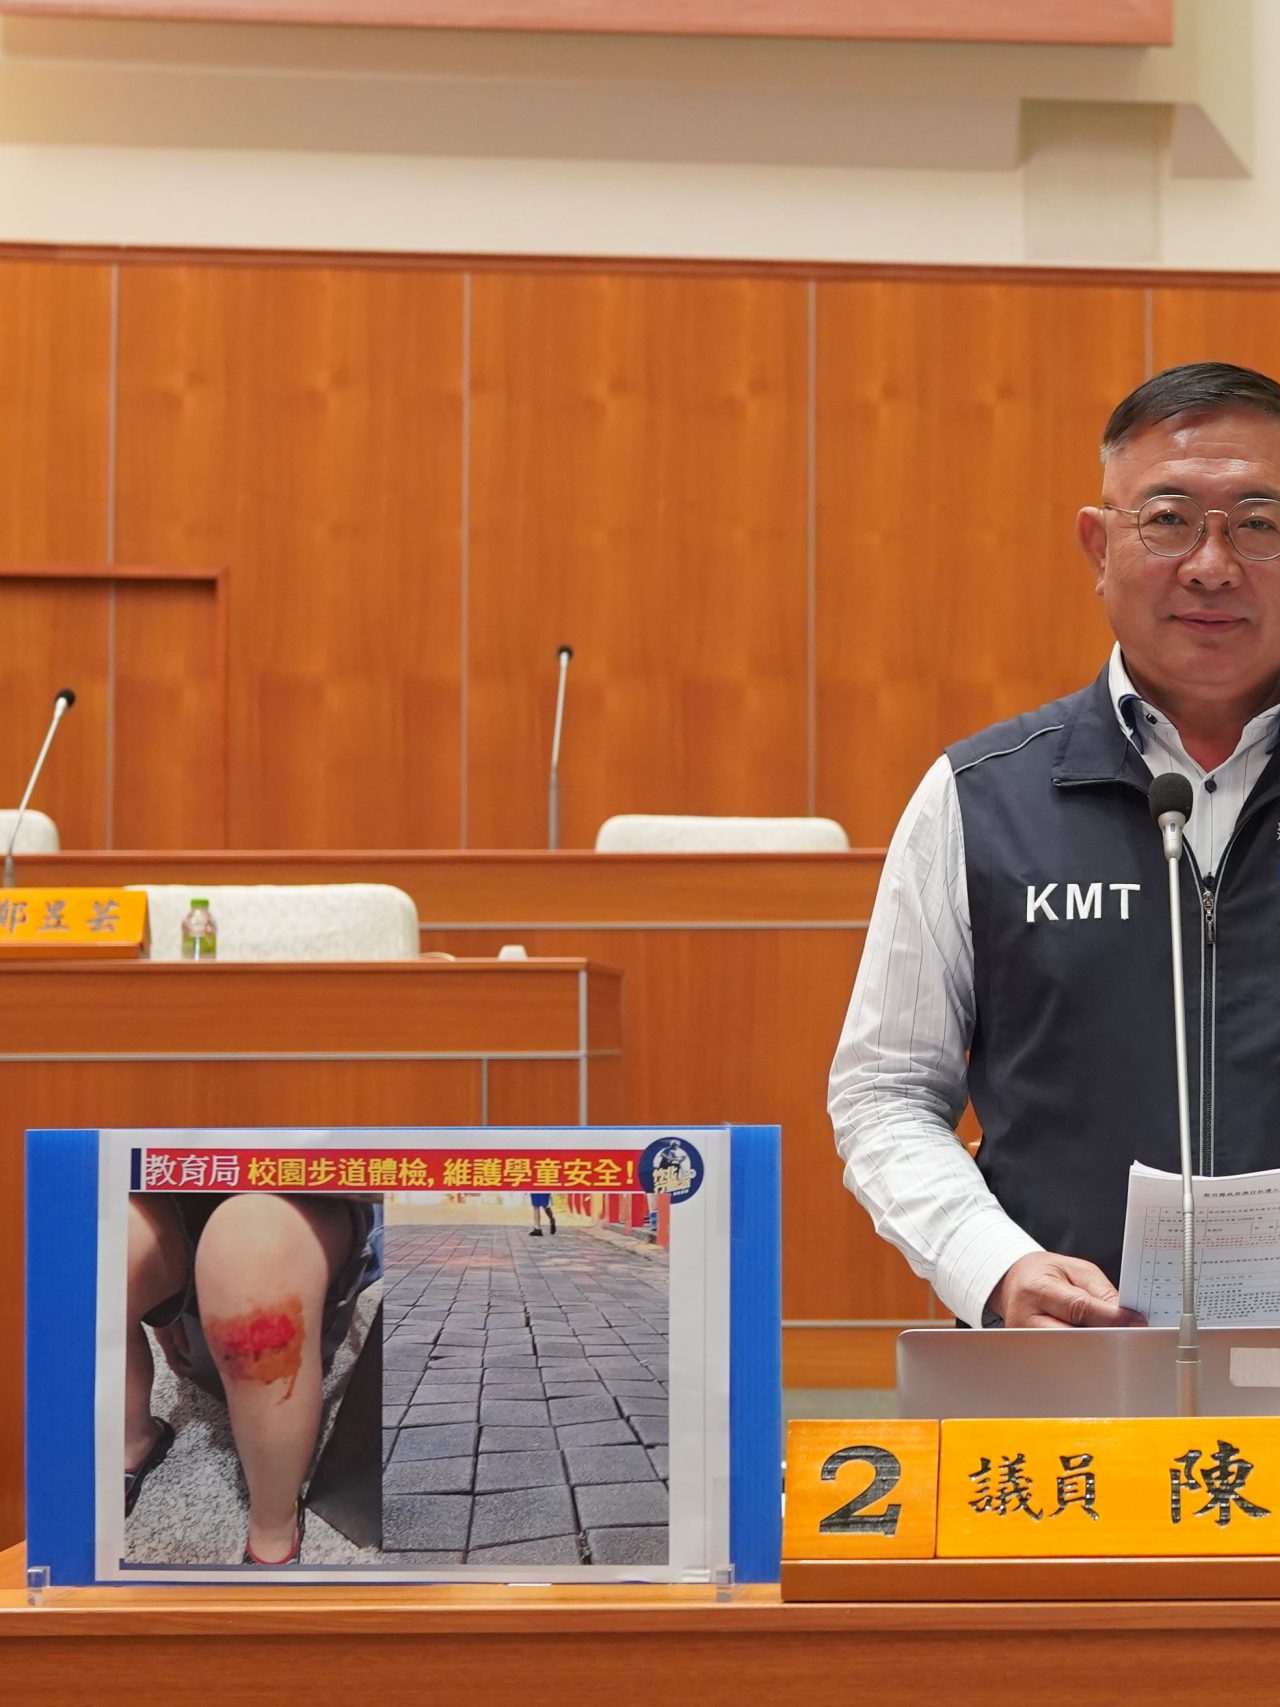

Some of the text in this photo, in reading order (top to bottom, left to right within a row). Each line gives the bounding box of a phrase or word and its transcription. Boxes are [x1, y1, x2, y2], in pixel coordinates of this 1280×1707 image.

[1025, 882, 1141, 923] KMT
[145, 1153, 241, 1188] 教育局
[819, 1444, 901, 1537] 2
[968, 1453, 1101, 1522] 議員
